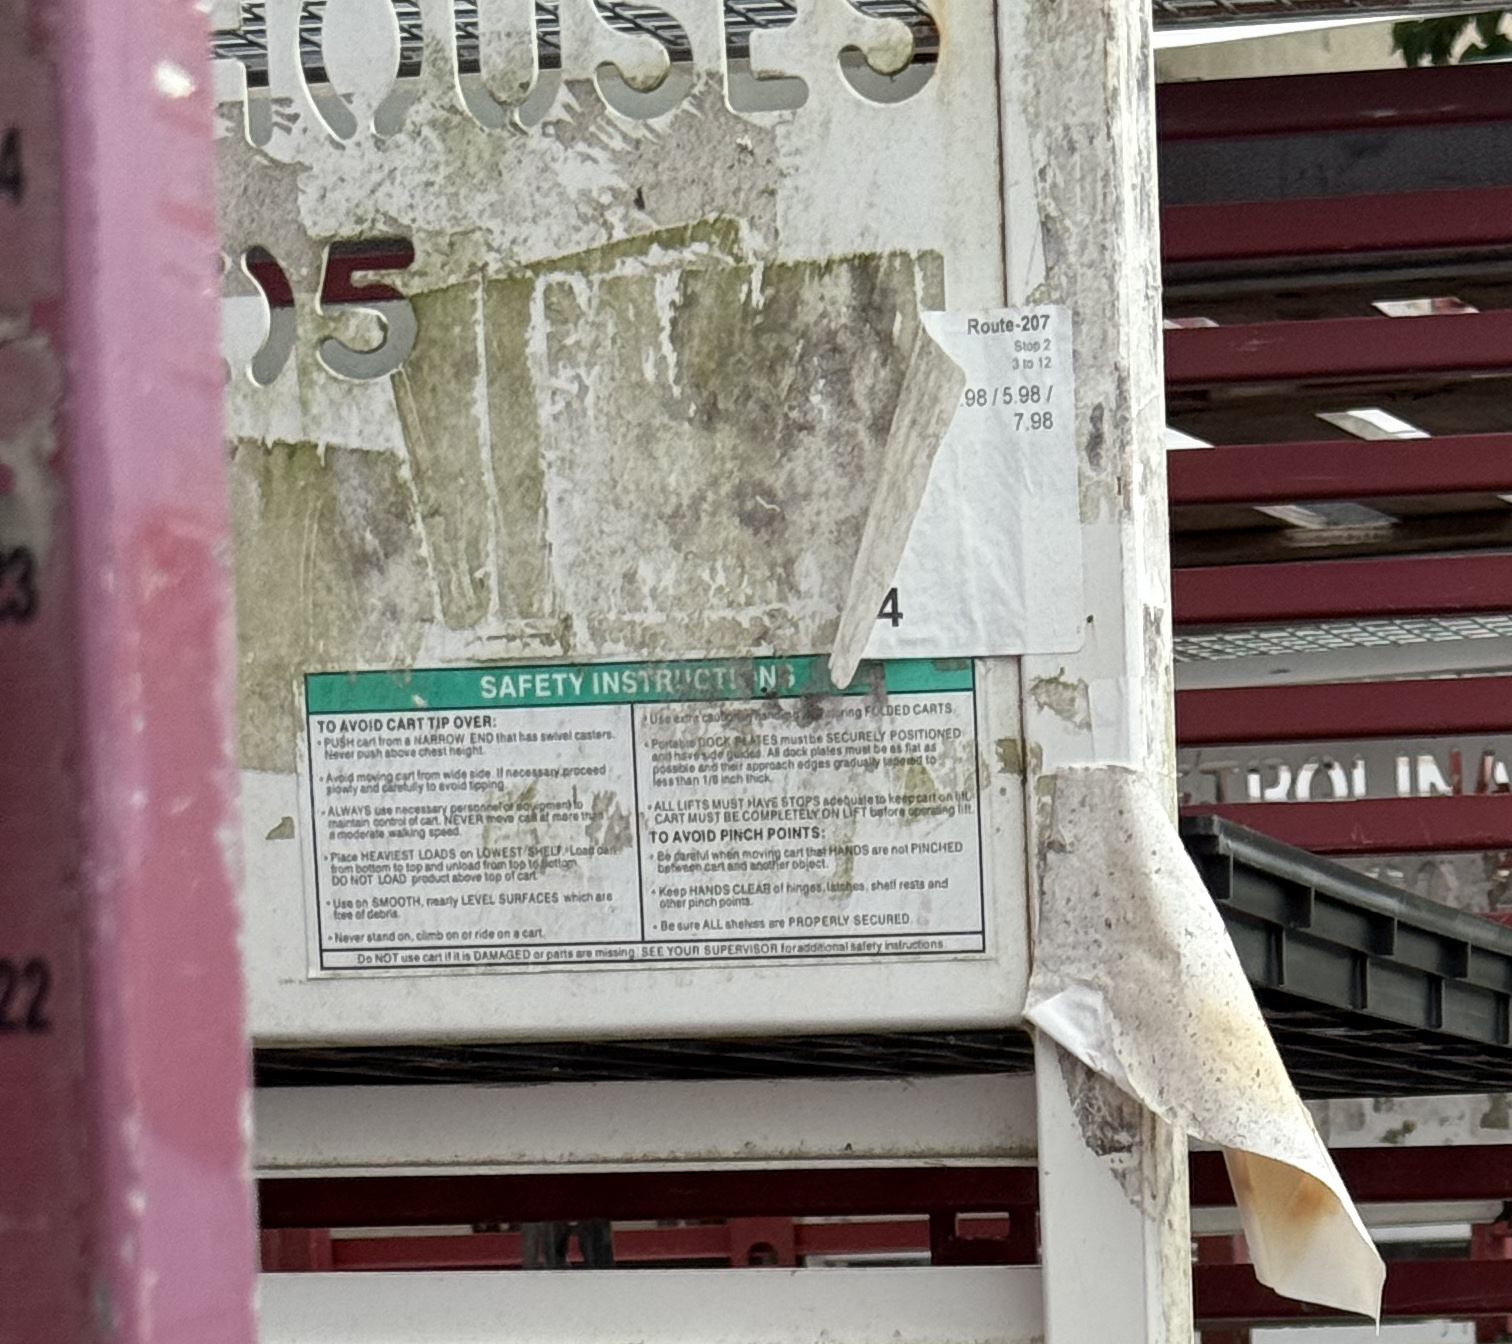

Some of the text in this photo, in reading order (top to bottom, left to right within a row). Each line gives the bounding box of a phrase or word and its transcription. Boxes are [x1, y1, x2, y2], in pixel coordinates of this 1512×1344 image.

[967, 314, 1051, 336] Route-207
[1014, 338, 1051, 353] Stop 2
[1023, 358, 1034, 369] to
[1038, 355, 1052, 368] 12
[1002, 384, 1041, 405] 5.98
[1013, 411, 1053, 431] 7.98
[480, 671, 584, 698] SAFETY
[318, 716, 496, 732] TO AVOID CART TIP OVER:
[323, 737, 354, 747] PUSH
[378, 736, 400, 745] from
[413, 734, 464, 744] NARROW
[469, 733, 493, 743] END
[495, 733, 516, 742] that
[517, 732, 538, 741] has
[540, 731, 572, 740] swivel
[650, 827, 825, 843] TO AVOID PINCH POINTS:
[657, 852, 671, 861] Be
[711, 850, 739, 859] when
[742, 848, 781, 860] moving
[783, 847, 804, 857] cart
[805, 847, 826, 856] that
[828, 845, 869, 855] HANDS
[891, 844, 908, 854] not
[910, 843, 963, 853] PINCHED
[331, 876, 347, 885] DO
[350, 876, 373, 885] NOT
[378, 875, 407, 884] LOAD
[411, 873, 450, 885] product
[451, 873, 482, 882] above
[484, 872, 501, 883] top
[504, 872, 514, 880] of
[332, 899, 353, 909] Use
[425, 896, 458, 908] nearly
[460, 895, 495, 905] LEVEL
[498, 893, 558, 904] SURFACES
[563, 892, 593, 902] which
[661, 921, 675, 931] Be
[701, 920, 722, 929] ALL
[788, 916, 849, 927] PROPERLY
[334, 933, 365, 943] Never
[366, 932, 395, 942] stand
[397, 934, 413, 943] on,
[415, 931, 443, 940] climb
[475, 929, 494, 939] ride
[357, 954, 371, 963] Do
[374, 954, 399, 963] NOT
[422, 953, 442, 962] cart
[473, 950, 530, 960] DAMAGED
[546, 949, 572, 960] parts
[641, 947, 664, 956] SEE
[667, 946, 700, 955] YOUR
[703, 944, 777, 954] SUPERVISOR
[850, 941, 882, 952] safety
[0, 960, 48, 1031] 22
